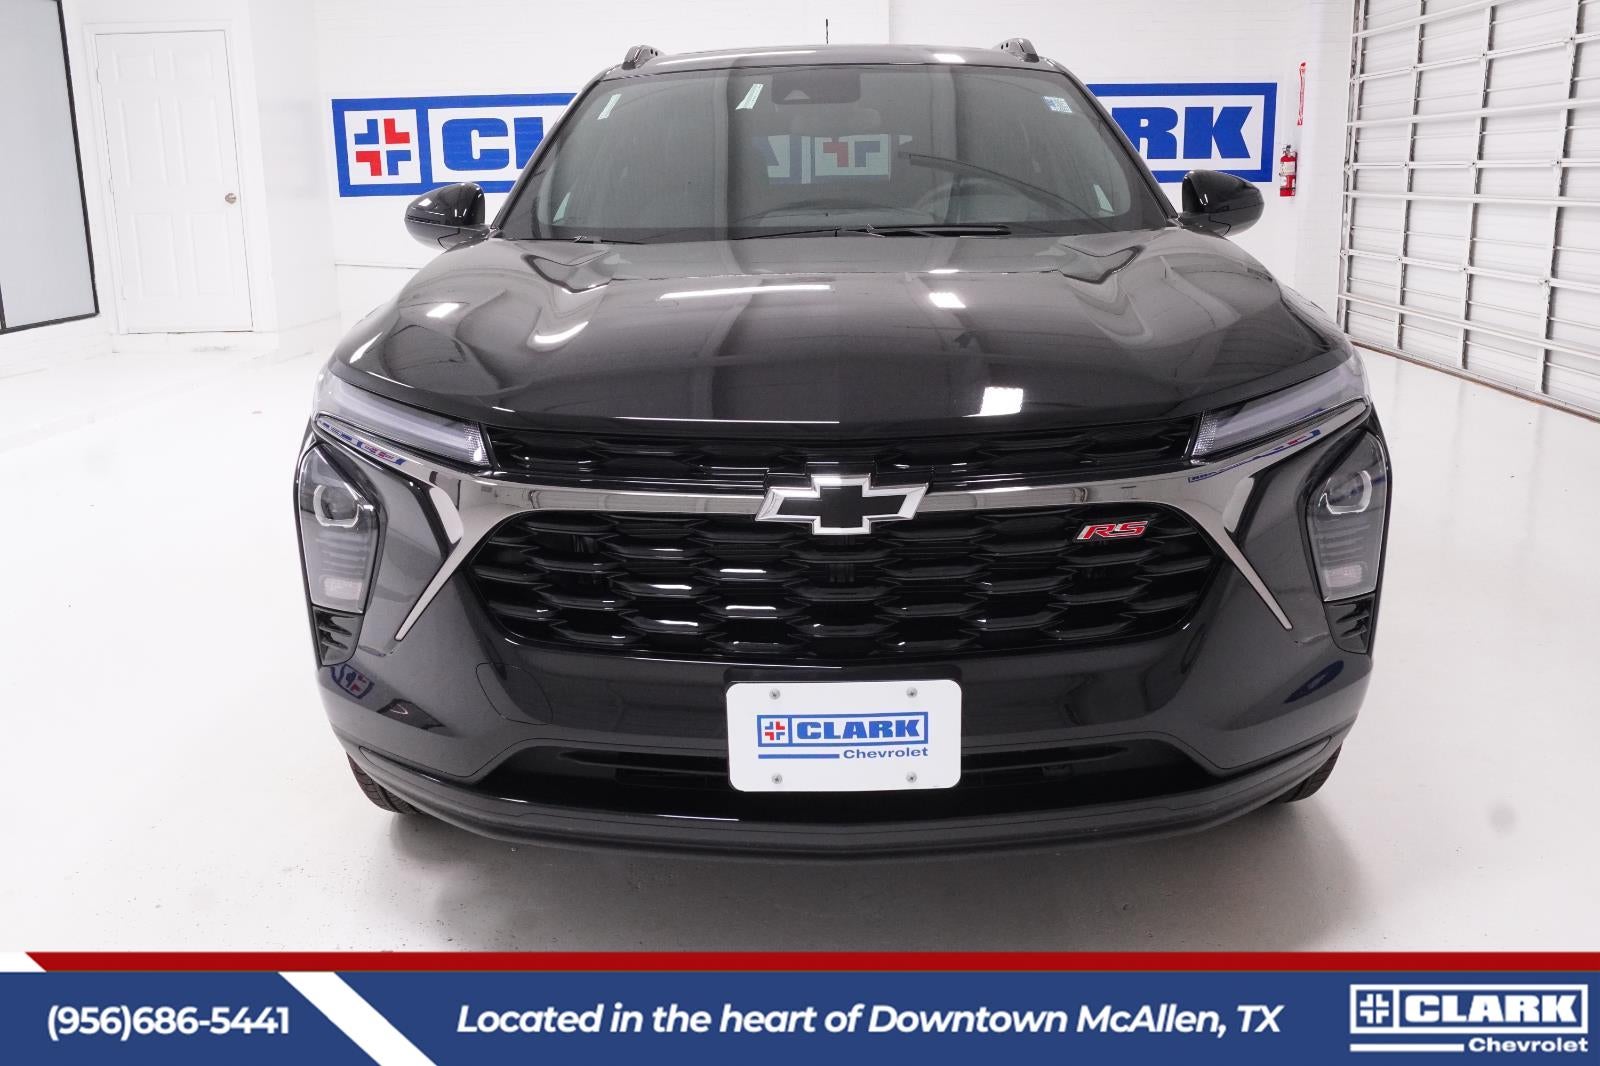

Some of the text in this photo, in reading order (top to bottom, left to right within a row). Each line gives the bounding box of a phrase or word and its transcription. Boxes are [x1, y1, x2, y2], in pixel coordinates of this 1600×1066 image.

[1076, 520, 1149, 540] RS
[796, 719, 920, 740] CLARK
[843, 747, 929, 760] Chevrolet
